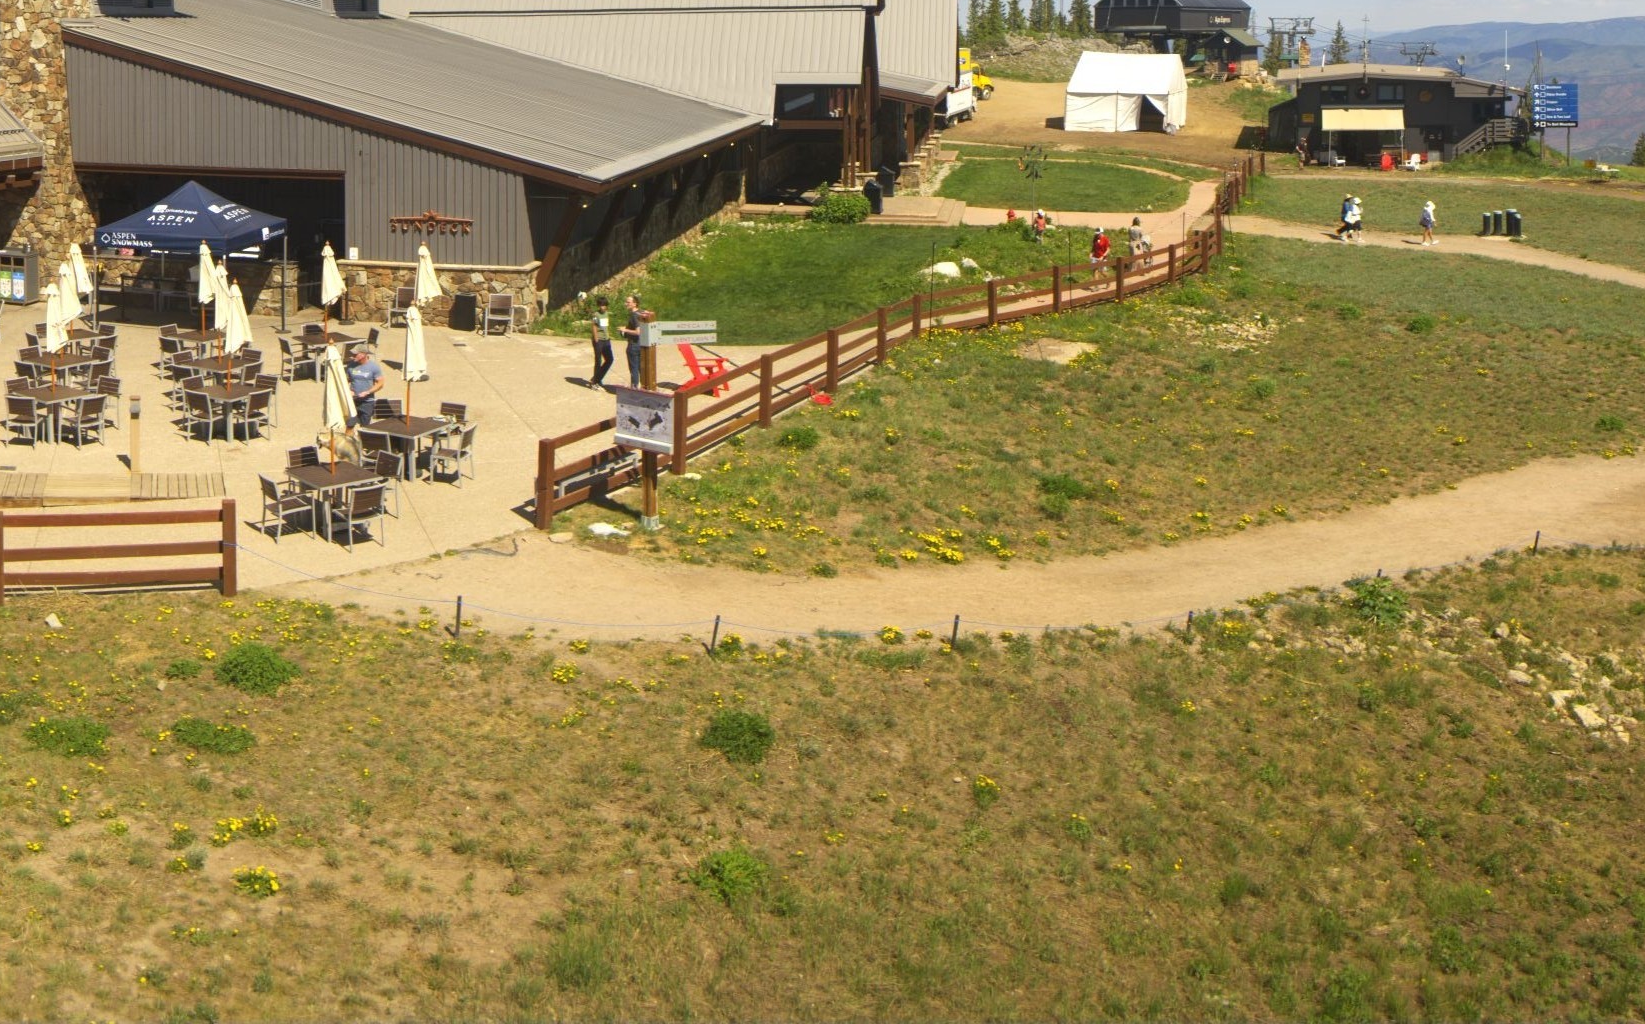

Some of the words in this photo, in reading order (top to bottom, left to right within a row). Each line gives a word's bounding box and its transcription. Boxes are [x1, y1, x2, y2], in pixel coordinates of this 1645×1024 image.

[147, 214, 195, 223] ASPEN
[390, 221, 471, 234] SUNDECK
[112, 232, 136, 240] ASPEN
[111, 239, 153, 248] SNOWMASS
